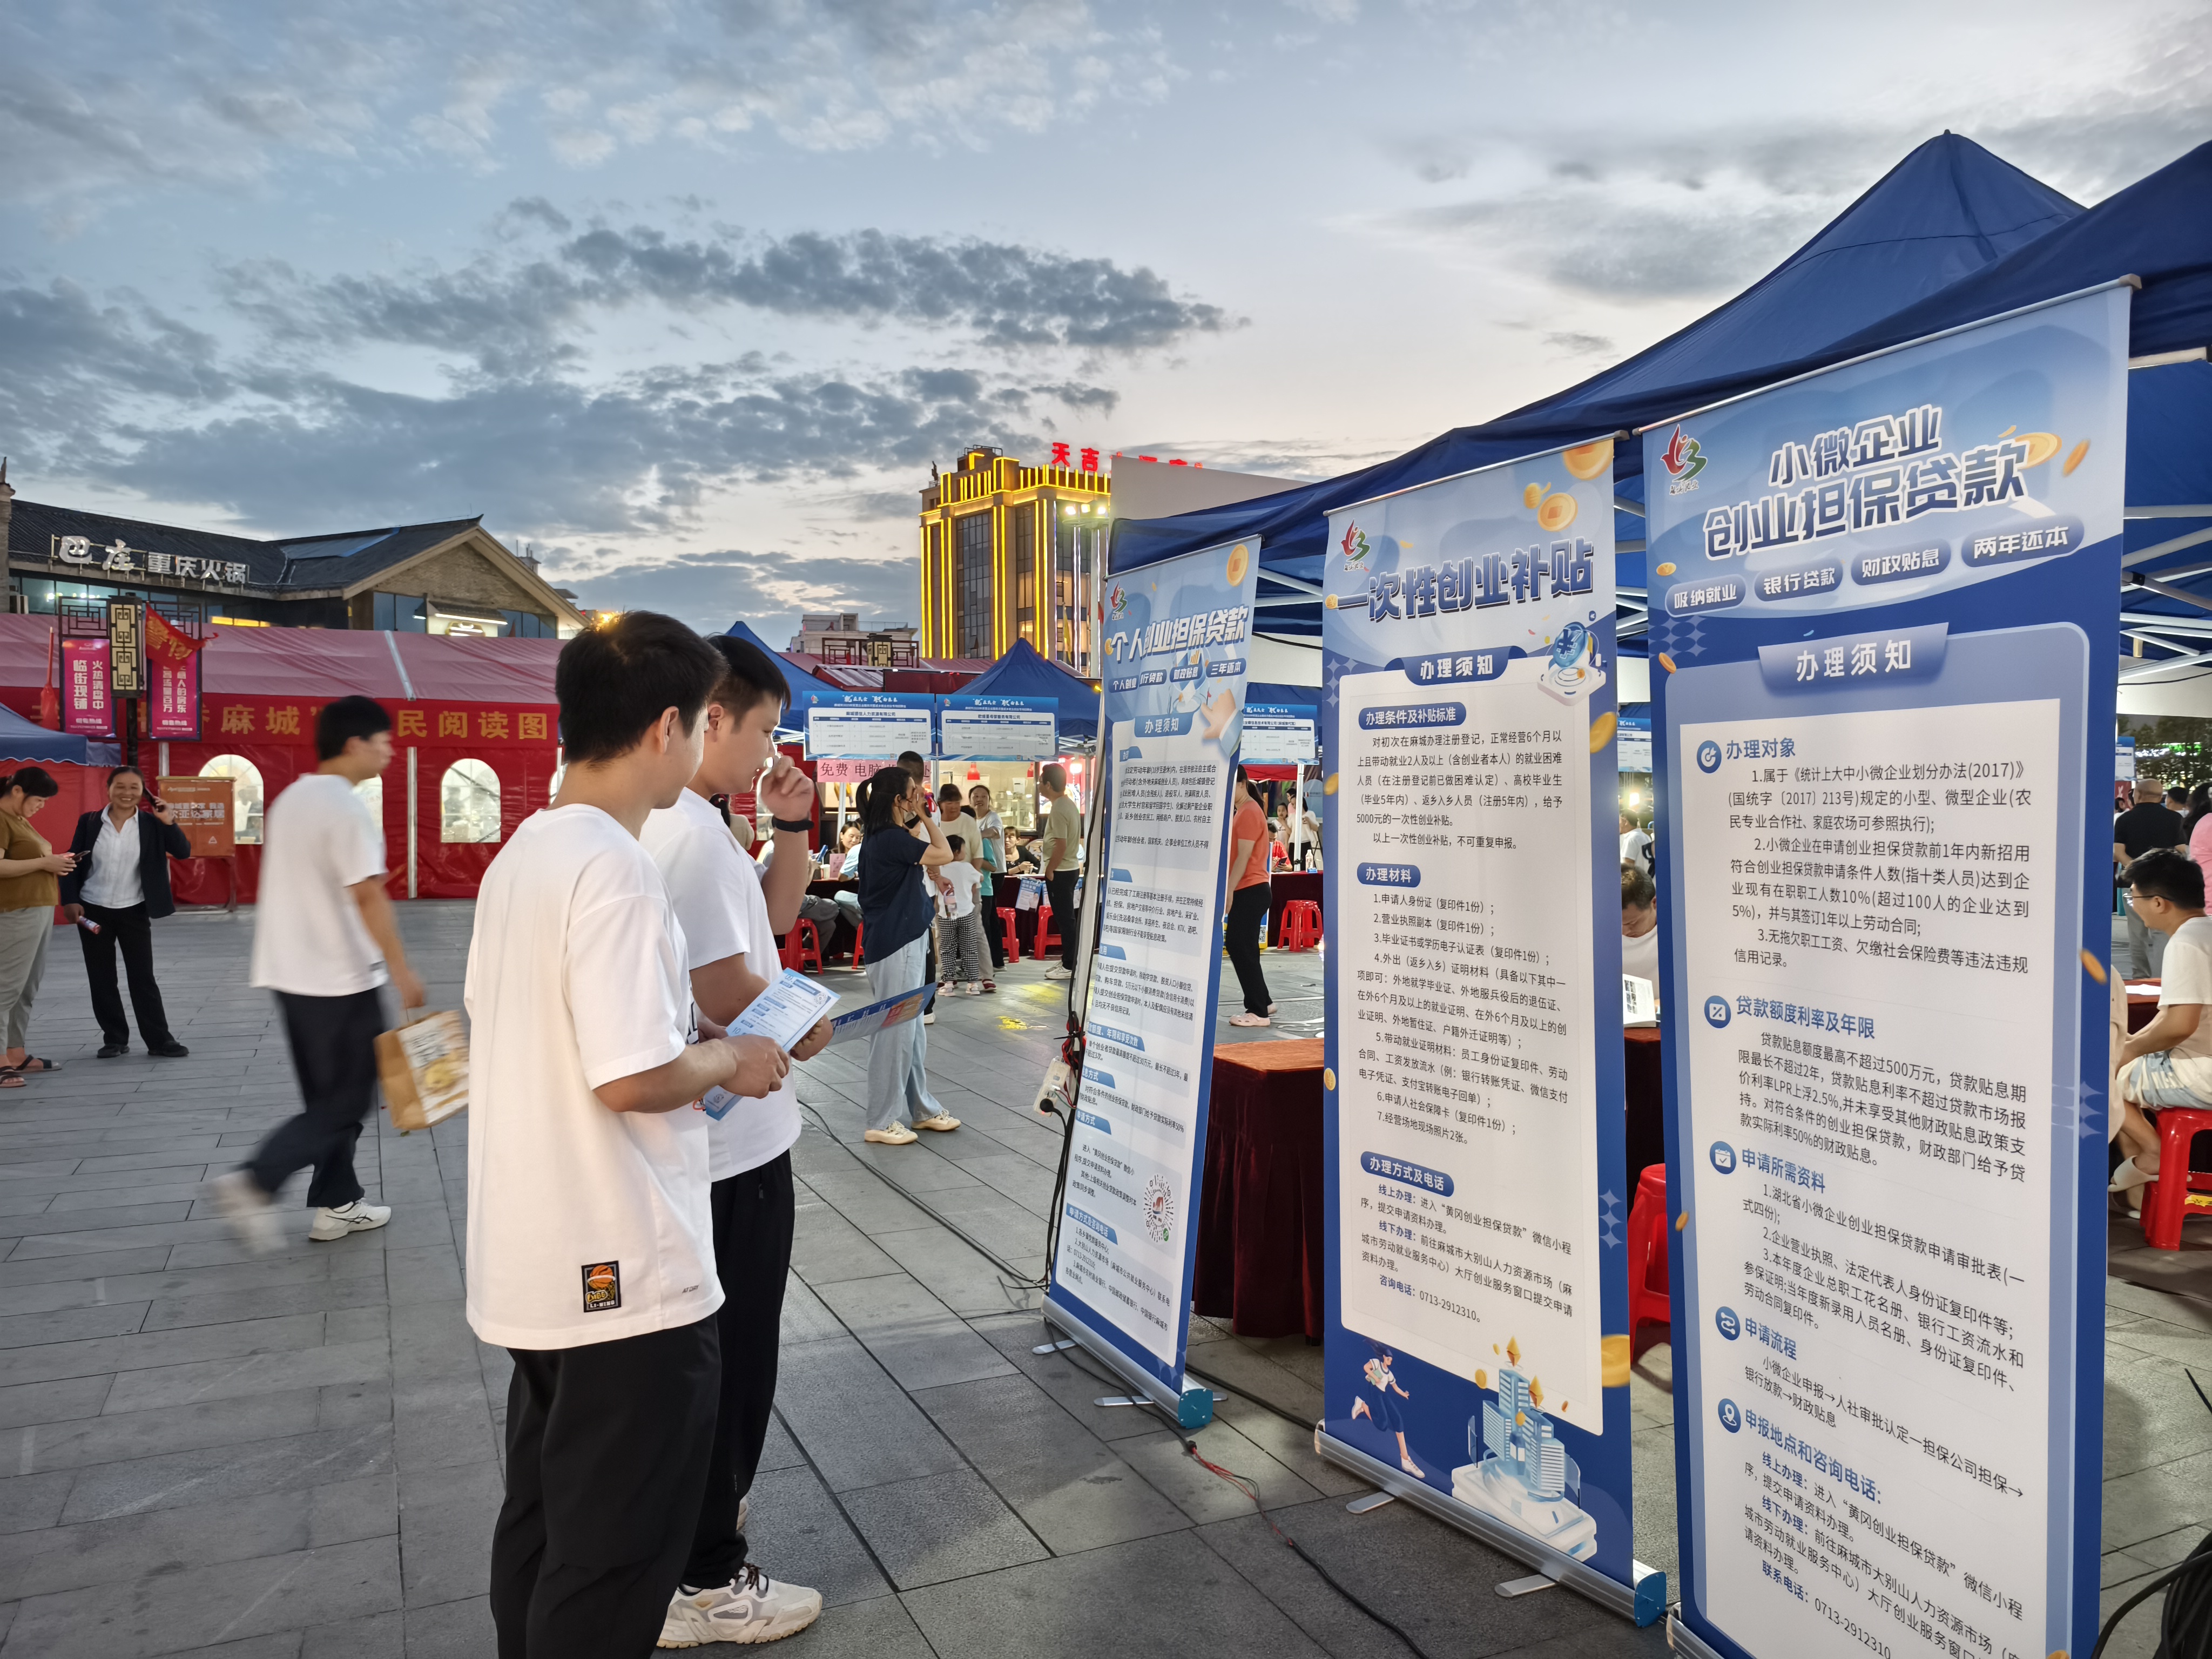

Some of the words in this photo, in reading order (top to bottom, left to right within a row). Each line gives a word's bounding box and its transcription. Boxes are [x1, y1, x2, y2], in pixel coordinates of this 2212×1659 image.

[1769, 400, 1942, 491] 小微企业
[1703, 435, 2029, 562] 创业担保贷款
[148, 551, 246, 584] 重庆火锅
[1337, 535, 1594, 624] 一次性创业补贴
[1674, 582, 1737, 610] 吸纳就业
[1763, 564, 1836, 597] 银行贷款
[1862, 545, 1940, 579] 财政贴息
[1973, 522, 2069, 561] 两年还本
[1112, 678, 1137, 691] 个人创业
[1173, 666, 1198, 681] 财政贴息
[1210, 660, 1241, 676] 三年还本
[1420, 655, 1493, 679] 办理须知
[1796, 636, 1911, 683] 办理须知
[92, 660, 104, 710] 火热清盘中
[1144, 717, 1179, 734] 办理须知
[1366, 707, 1455, 725] 办理条件及补贴标准
[1357, 752, 1562, 766] 上且带动就业2人及以上（含创业者本人）的就业困难
[1373, 730, 1561, 747] 对初次在麻城办理注册登记，正常经营6个月以
[1726, 737, 1796, 760] 办理对象
[820, 762, 848, 777] 免费
[1357, 774, 1562, 787] 人员（在注册登记前已做困难认定）、高校毕业生
[1752, 758, 2023, 785] 1.属于《统计上大中小微企业划分办法(2017)》
[1356, 812, 1453, 827] 5000元的一次性创业补贴。
[1361, 793, 1562, 808] （毕业5年内）、返乡入乡人员（注册5年内），给予
[1373, 832, 1516, 850] 以上一次性创业补贴，不可重复申报。
[1730, 814, 1935, 832] 民专业合作社、家庭农场可参照执行);
[1754, 837, 2029, 862] 2.小微企业在申请创业担保贷款前1年内新招用
[1366, 867, 1411, 882] 办理材料
[1731, 859, 2029, 890] 符合创业担保贷款申请条件人数(指十类人员)达到企
[1374, 892, 1494, 915] 1.申请人身份证（复印件1份）；
[1731, 881, 2029, 918] 业现有在职职工人数10%(超过100人的企业达到
[1732, 903, 1920, 936] 5%)，并与其签订1年以上劳动合同;
[1374, 912, 1494, 937] 2.营业执照副本（复印件1份）；
[1375, 932, 1549, 966] 3.毕业证书或学历电子认证表（复印件1份）；
[1734, 948, 1789, 968] 信用记录。
[1757, 927, 2028, 973] 3.无拖欠职工工资、欠缴社会保险费等违法违规
[1357, 969, 1561, 1013] 项即可：外地就学毕业证、外地服兵役后的退伍证、
[1374, 952, 1566, 990] 4.外出（返乡入乡）证明材料（具备以下其中一
[1358, 989, 1566, 1036] 在外6个月及以上的就业证明、在外6个月及以上的创
[1358, 1008, 1521, 1050] 业证明、外地暂住证、户籍外迁证明等）；
[1736, 995, 1874, 1038] 贷款额度利率及年限
[1358, 1047, 1568, 1104] 合同、工资发放流水（例：银行转账凭证、微信支付
[1376, 1031, 1567, 1081] 5.带动就业证明材料：员工身份证复印件、劳动
[1761, 1031, 2026, 1102] 贷款贴息额度最高不超过500万元，贷款贴息期
[1359, 1067, 1491, 1108] 电子凭证、支付宝转账电子回单）；
[1738, 1049, 2026, 1130] 限最长不超过2年，贷款贴息利率不超过贷款市场报
[1378, 1089, 1515, 1136] 6.申请人社会保障卡（复印件1份）；
[1378, 1110, 1468, 1145] 7.经营场地现场照片2张。
[1739, 1070, 2026, 1156] 价利率LPR上浮2.5%,并未享受其他财政贴息政策支
[1739, 1091, 2025, 1183] 持。对符合条件的创业担保贷款，财政部门给予贷
[1740, 1112, 1878, 1166] 款实际利率50%的财政贴息。
[1370, 1156, 1444, 1191] 办理方式及电话
[1742, 1148, 1825, 1194] 申请所需资料
[1361, 1196, 1446, 1235] 序，提交申请资料办理。
[1379, 1183, 1571, 1256] 线上办理：进入“黄冈创业担保贷款”微信小程
[1743, 1198, 1780, 1225] 式四份);
[1379, 1219, 1572, 1298] 线下办理：前往麻城市大别山人力资源市场（麻
[1763, 1184, 2025, 1290] 1.湖北省小微企业创业担保贷款申请审批表(一
[1362, 1250, 1398, 1273] 资料办理。
[1362, 1231, 1572, 1319] 城市劳动就业服务中心）大厅创业服务窗口提交申请
[1380, 1273, 1480, 1325] 咨询电话：0713-2912310。
[1763, 1227, 2012, 1341] 2.企业营业执照、法定代表人身份证复印件等;
[1744, 1282, 1818, 1330] 劳动合同复印件。
[1744, 1260, 2015, 1392] 参保证明;当年度新录用人员名册、身份证复印件、
[1763, 1247, 2022, 1369] 3.本年度企业总职工花名册、银行工资流水和
[1745, 1317, 1796, 1360] 申请流程
[1745, 1461, 1854, 1543] 序，提交申请资料办理。
[1744, 1525, 1799, 1575] 请资料办理。
[1762, 1451, 2022, 1621] 线上办理：进入“黄冈创业担保贷款”微信小程
[1745, 1504, 1982, 1659] 城市劳动就业服务中心）大厅创业服务窗口
[1762, 1494, 2020, 1659] 线下办理：前往麻城市大别山人力资源市场（
